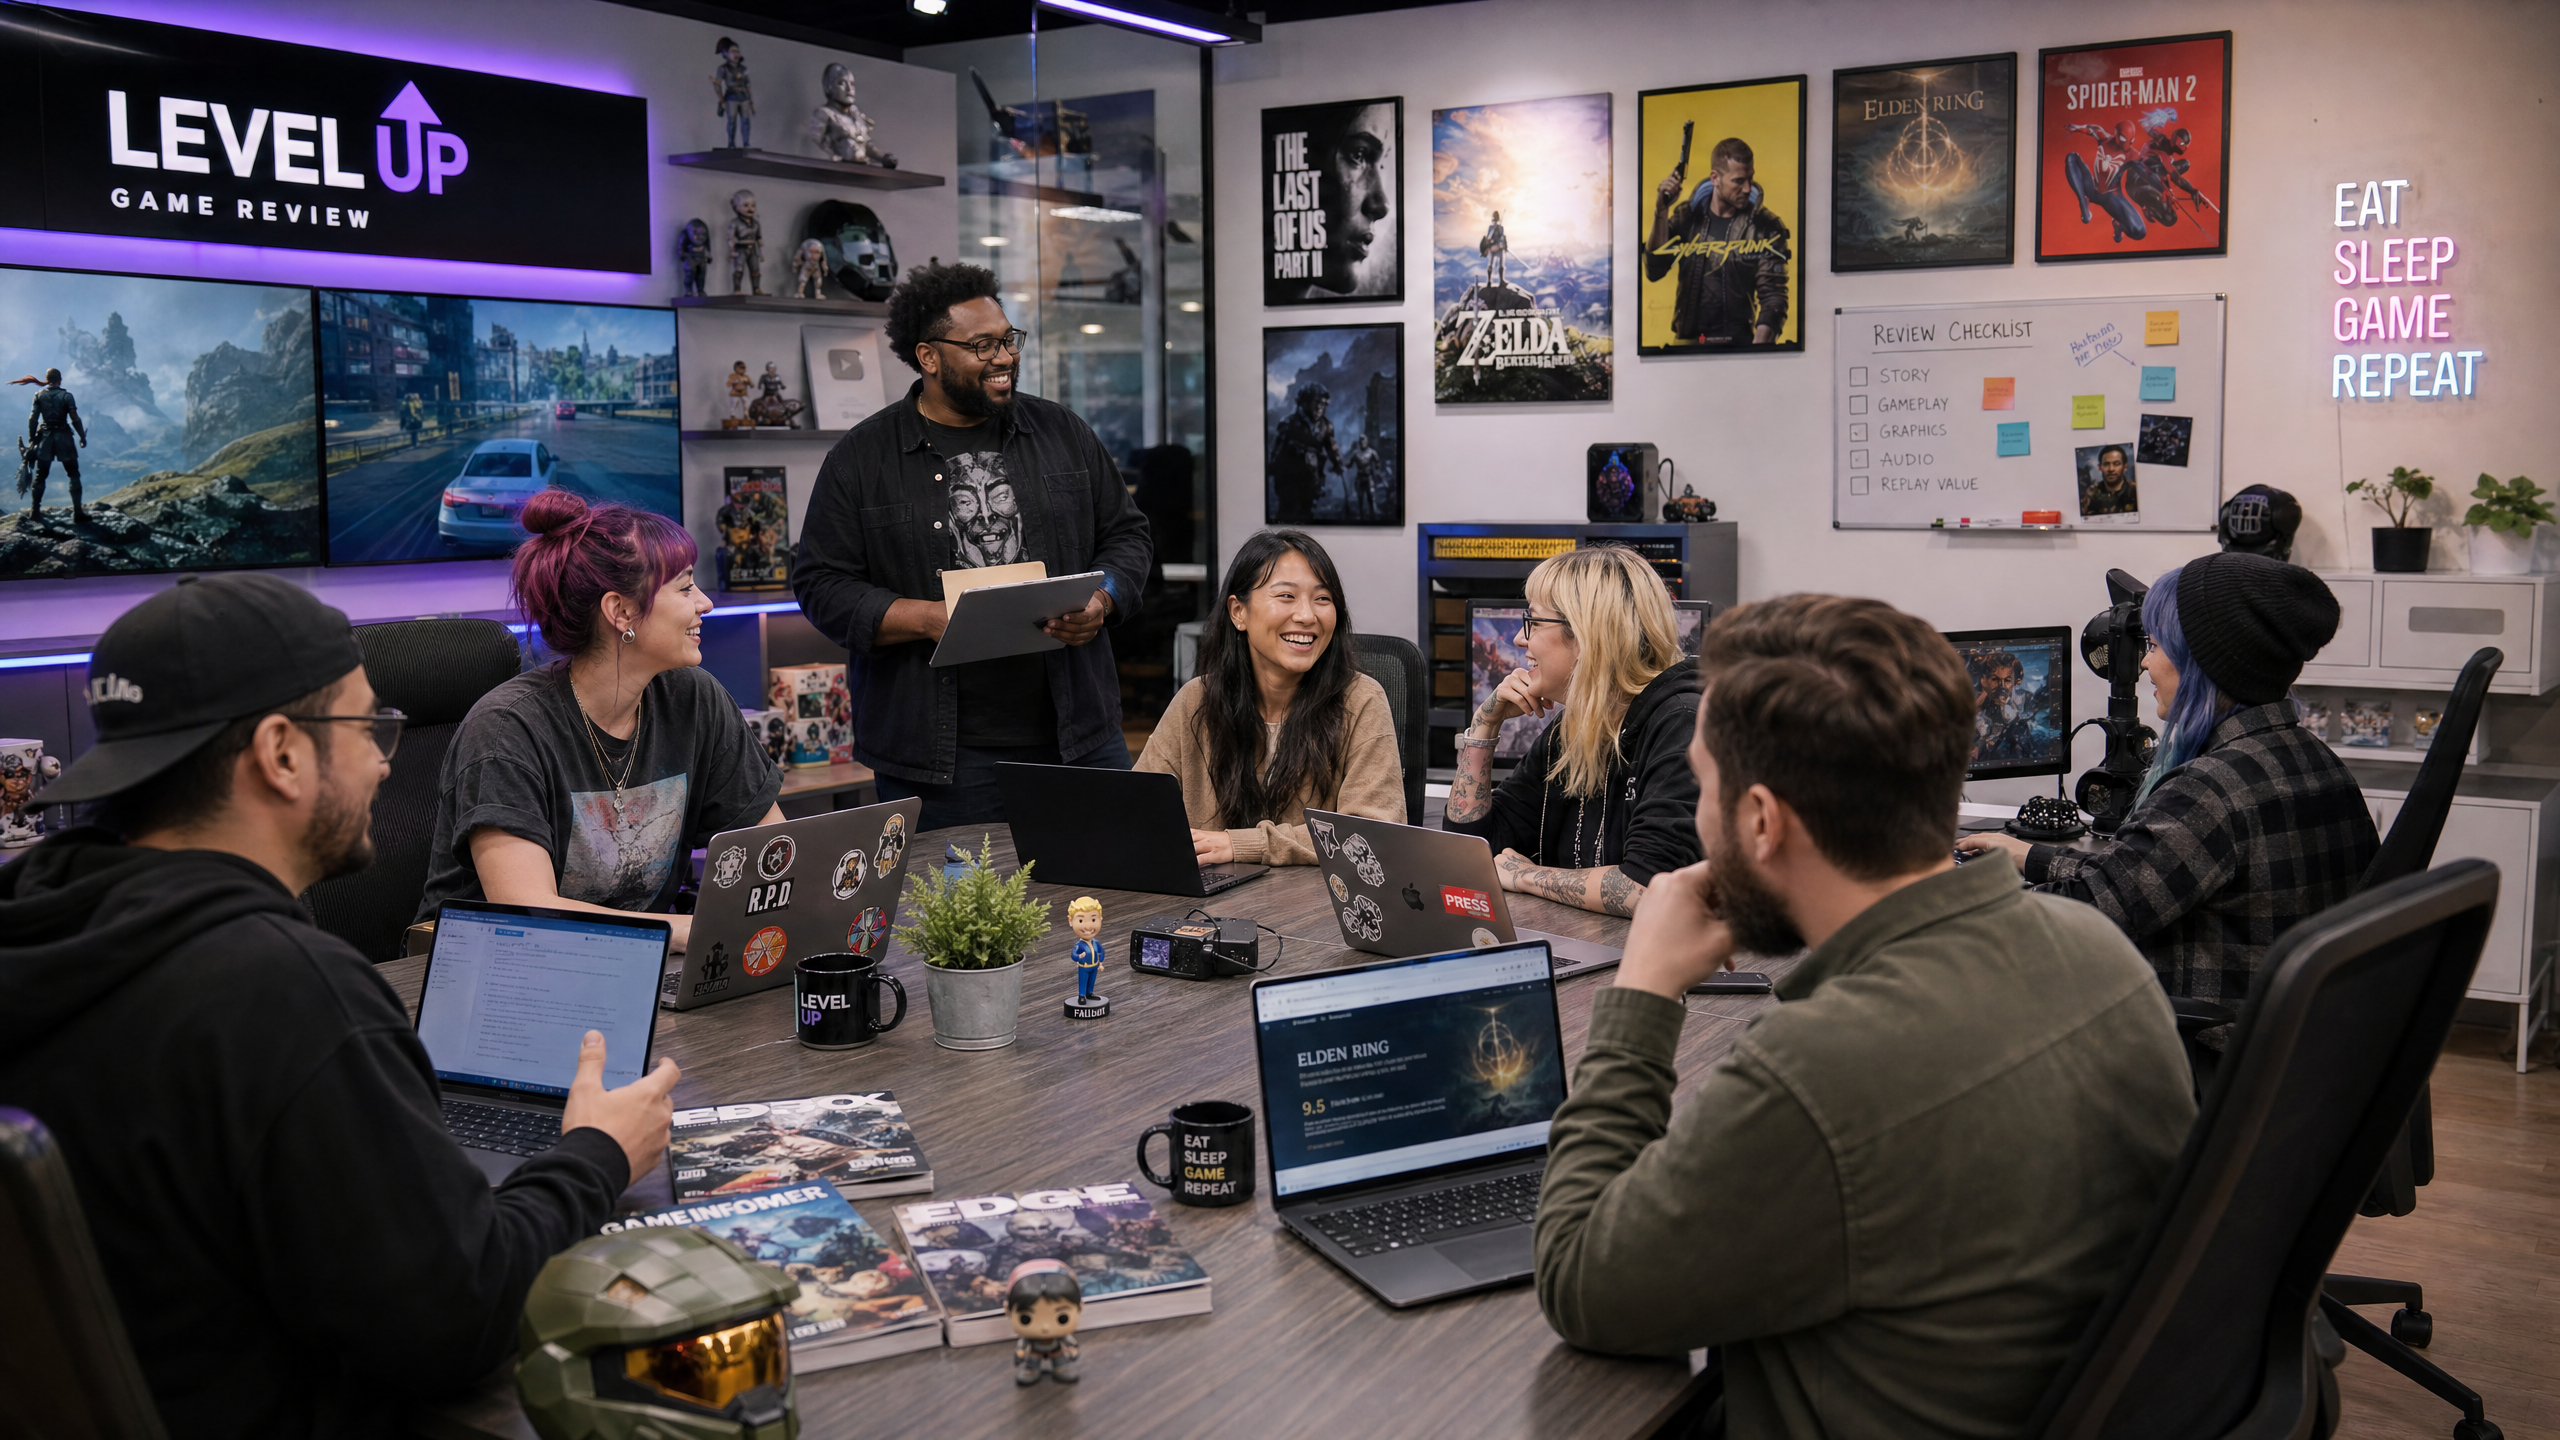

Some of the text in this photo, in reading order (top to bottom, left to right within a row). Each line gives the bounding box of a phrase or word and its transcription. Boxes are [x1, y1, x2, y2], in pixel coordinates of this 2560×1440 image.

[1863, 90, 1984, 121] ELDEN RING
[2066, 74, 2197, 110] SPIDER-MAN 2
[107, 80, 469, 195] LEVEL UP
[1273, 131, 1309, 172] THE
[1272, 170, 1322, 211] LAST
[2334, 179, 2409, 227] EAT
[110, 187, 369, 229] GAME REVIEW
[1273, 211, 1298, 251] OF
[1273, 250, 1323, 279] PART II
[2333, 236, 2455, 285] SLEEP
[1873, 318, 2034, 346] REVIEW CHECKLIST
[2333, 293, 2451, 342] GAME
[1455, 309, 1572, 367] ZELDA
[1880, 367, 1930, 383] STORY
[2332, 351, 2484, 398] REPEAT
[1878, 397, 1949, 413] GAMEPLAY
[1879, 423, 1948, 439] GRAPHICS
[1879, 452, 1935, 467] AUDIO
[1881, 476, 1980, 492] REPLAY VALUE
[1444, 893, 1490, 913] PRESS
[800, 991, 851, 1011] LEVEL
[801, 1008, 822, 1026] UP
[1297, 1039, 1390, 1068] ELDEN RING
[1302, 1099, 1326, 1117] 9.5
[1183, 1133, 1211, 1149] EAT
[1184, 1149, 1228, 1165] SLEEP
[1184, 1165, 1226, 1180] GAME
[1184, 1180, 1237, 1196] REPEAT
[903, 1182, 1141, 1225] EDGE
